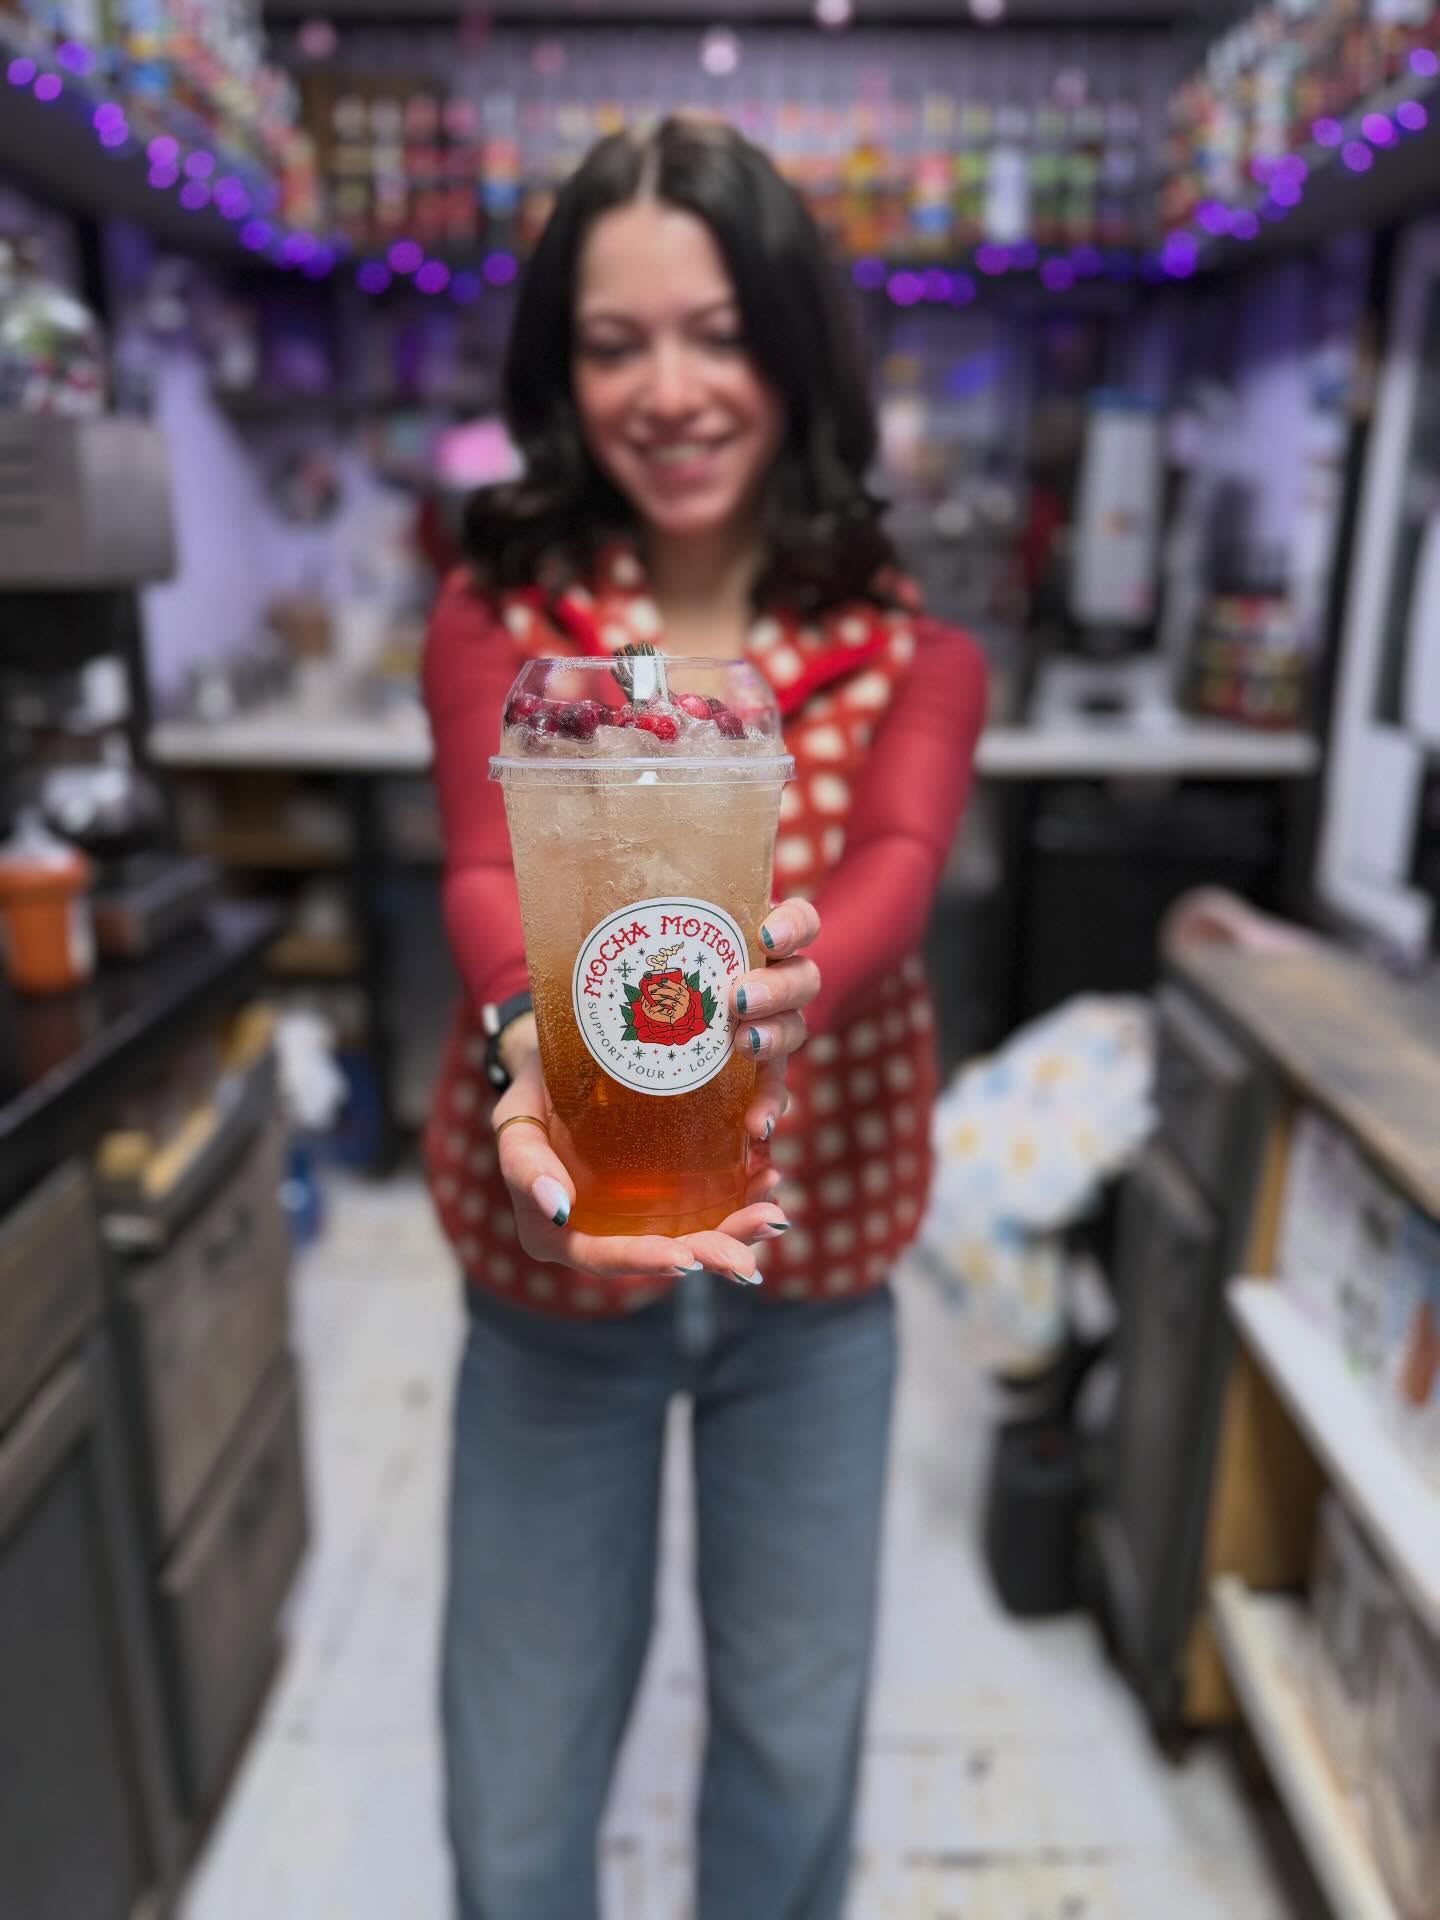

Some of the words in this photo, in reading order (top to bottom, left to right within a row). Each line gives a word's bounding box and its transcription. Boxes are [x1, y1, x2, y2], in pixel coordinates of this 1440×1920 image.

[584, 921, 651, 998] MOCHA
[660, 915, 740, 975] MOTION
[588, 1001, 625, 1062] SUPPORT
[626, 1060, 665, 1079] YOUR
[689, 1038, 725, 1073] LOCAL
